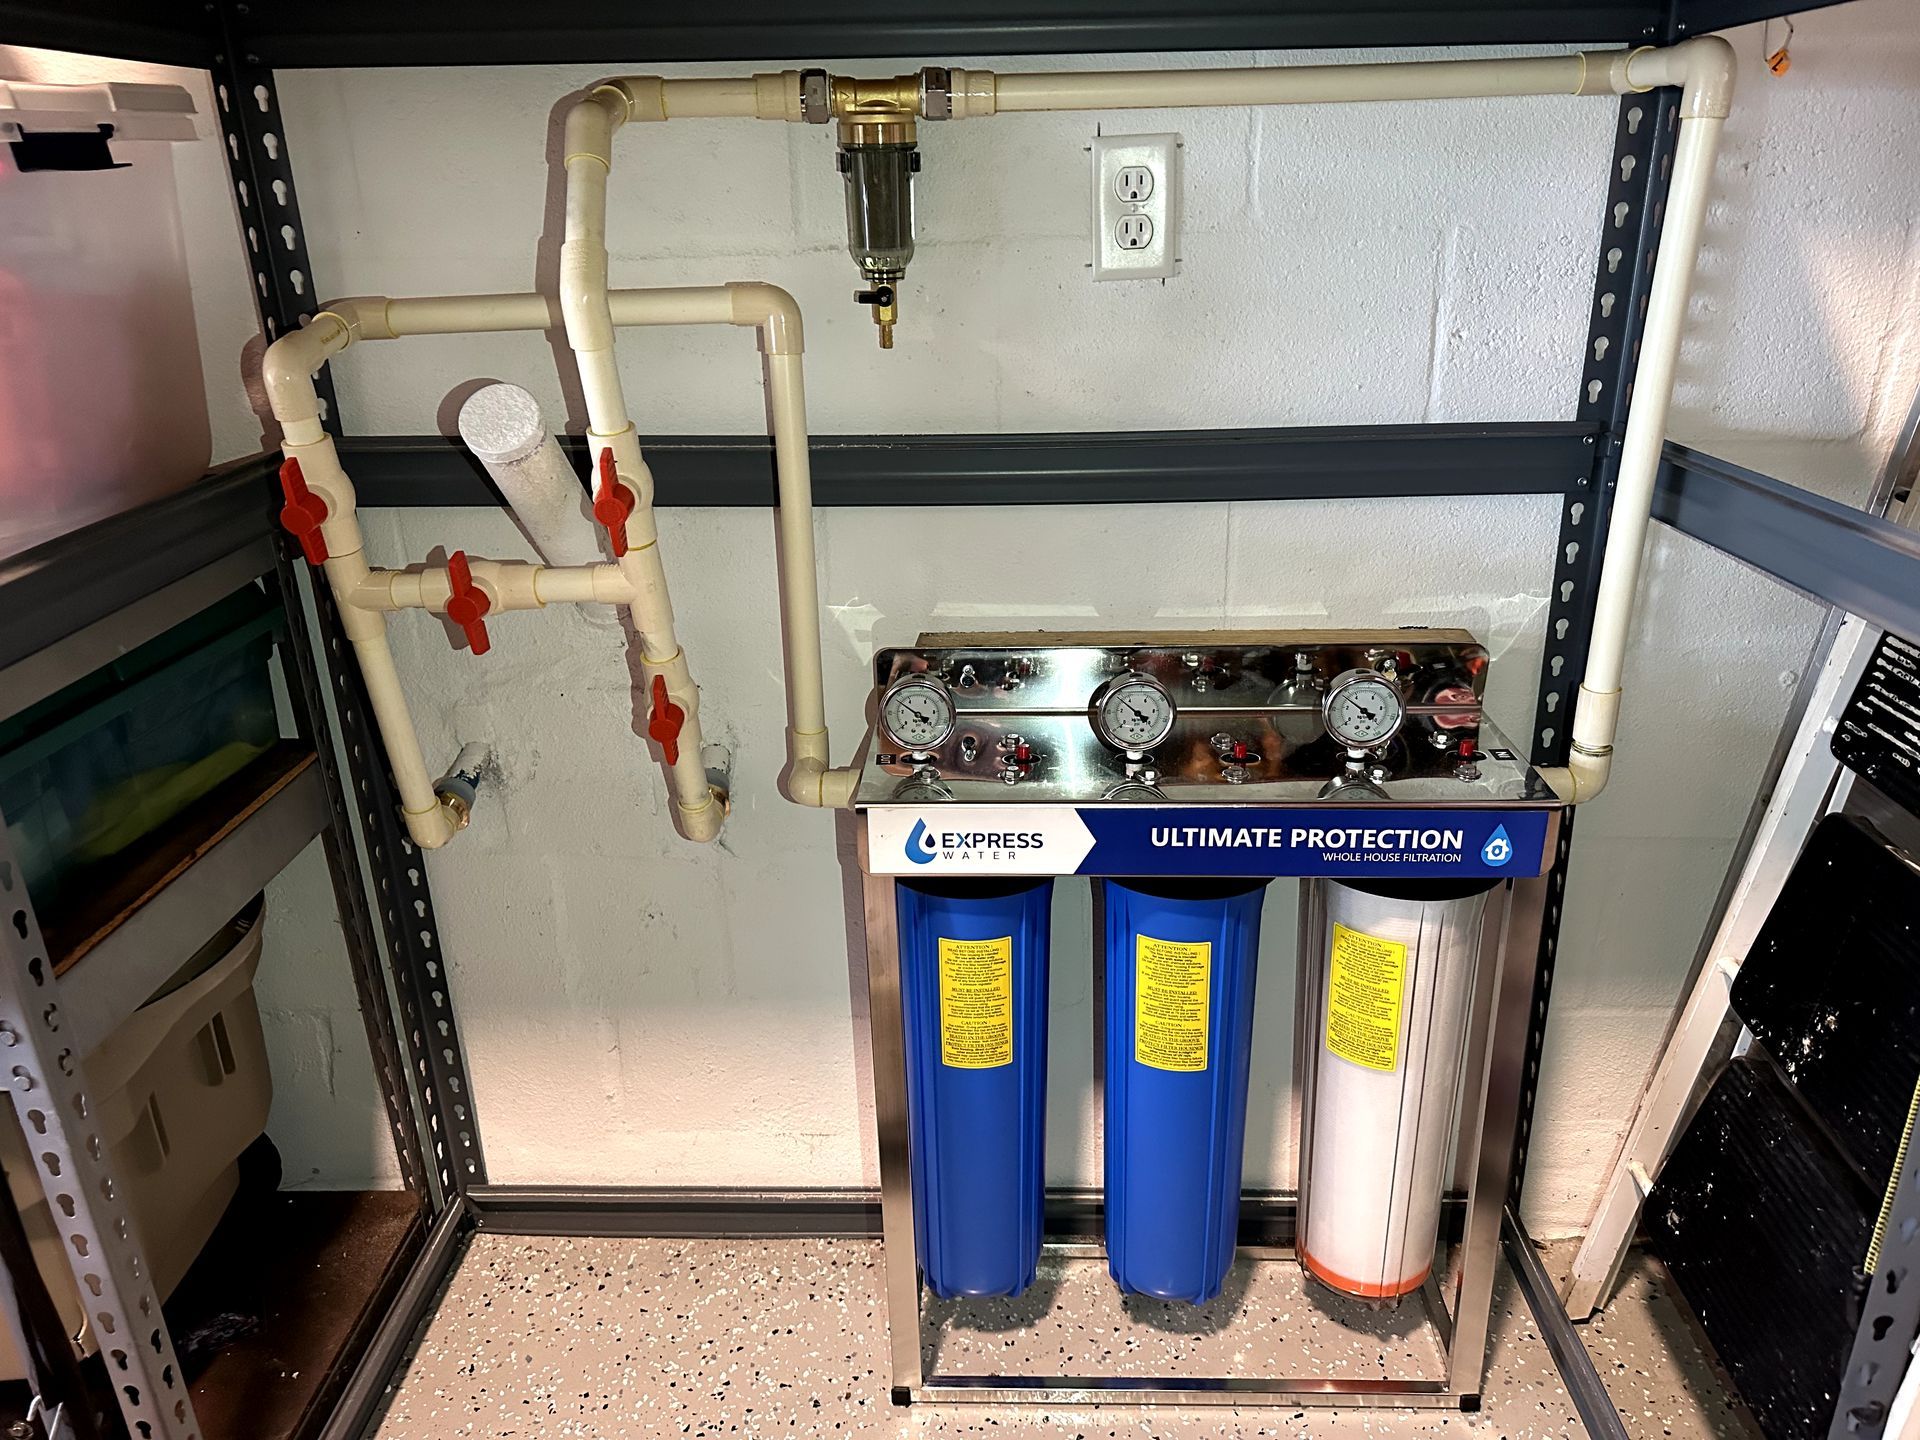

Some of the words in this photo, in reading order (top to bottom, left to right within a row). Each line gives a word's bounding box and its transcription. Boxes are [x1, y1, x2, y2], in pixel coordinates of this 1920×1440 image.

[942, 833, 1043, 849] EXPRESS
[1152, 828, 1281, 847] ULTIMATE
[1291, 829, 1463, 849] PROTECTION
[1323, 852, 1361, 861] WHOLE
[1364, 853, 1400, 862] HOUSE
[1403, 853, 1461, 862] FILTRATION
[1348, 934, 1381, 947] ATTENTION
[1346, 1012, 1371, 1023] CAUTION
